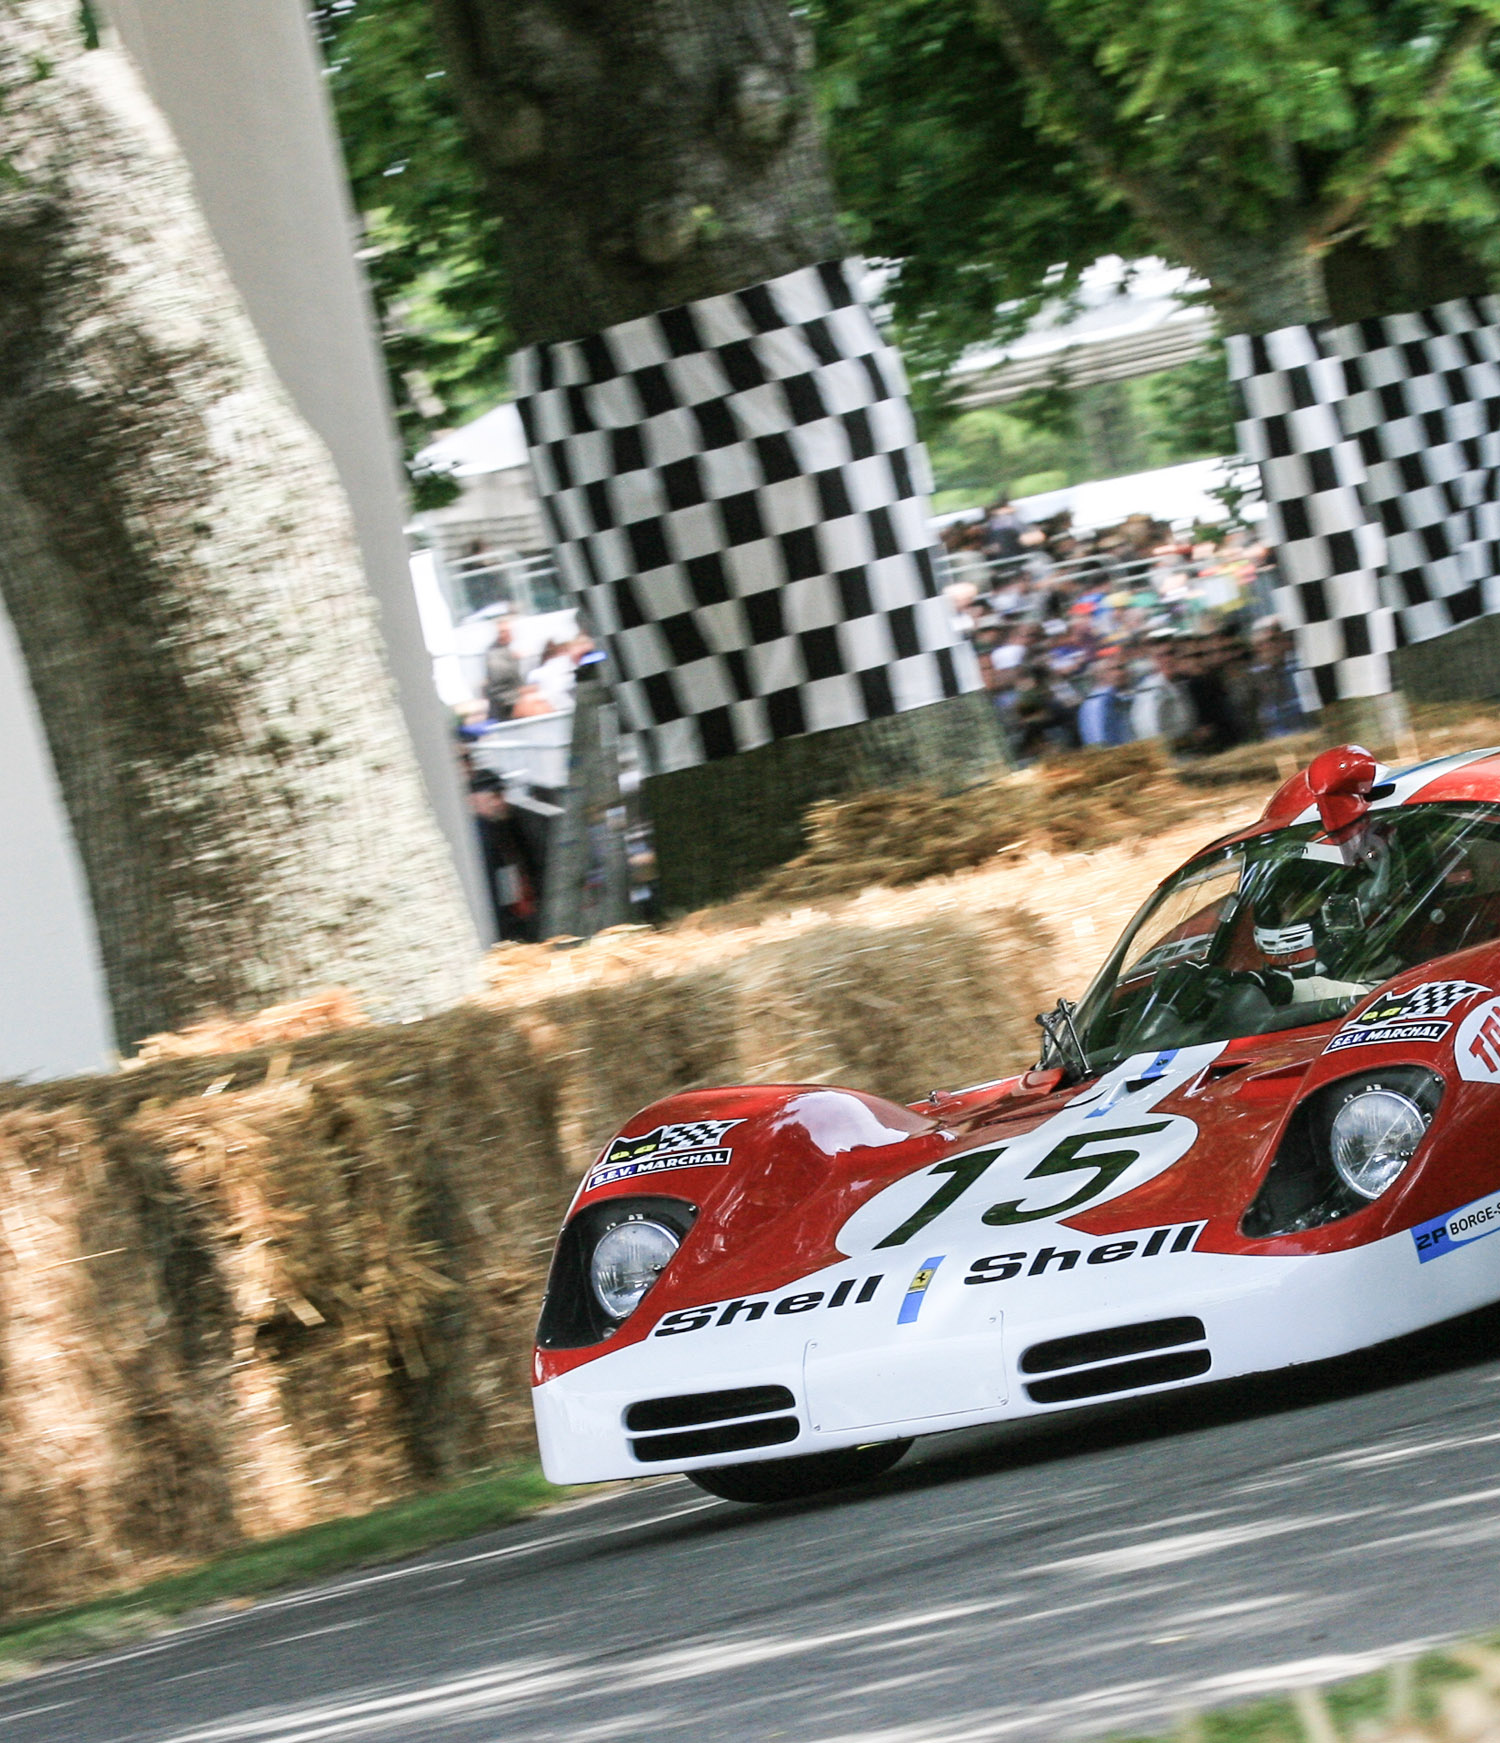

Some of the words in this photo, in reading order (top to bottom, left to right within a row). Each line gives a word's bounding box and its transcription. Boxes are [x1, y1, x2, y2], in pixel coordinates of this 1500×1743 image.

[1365, 1025, 1440, 1042] MARCHAL
[636, 1152, 724, 1172] MARCHAL
[873, 1120, 1174, 1250] 15
[654, 1274, 884, 1337] Shell
[964, 1225, 1199, 1285] Shell
